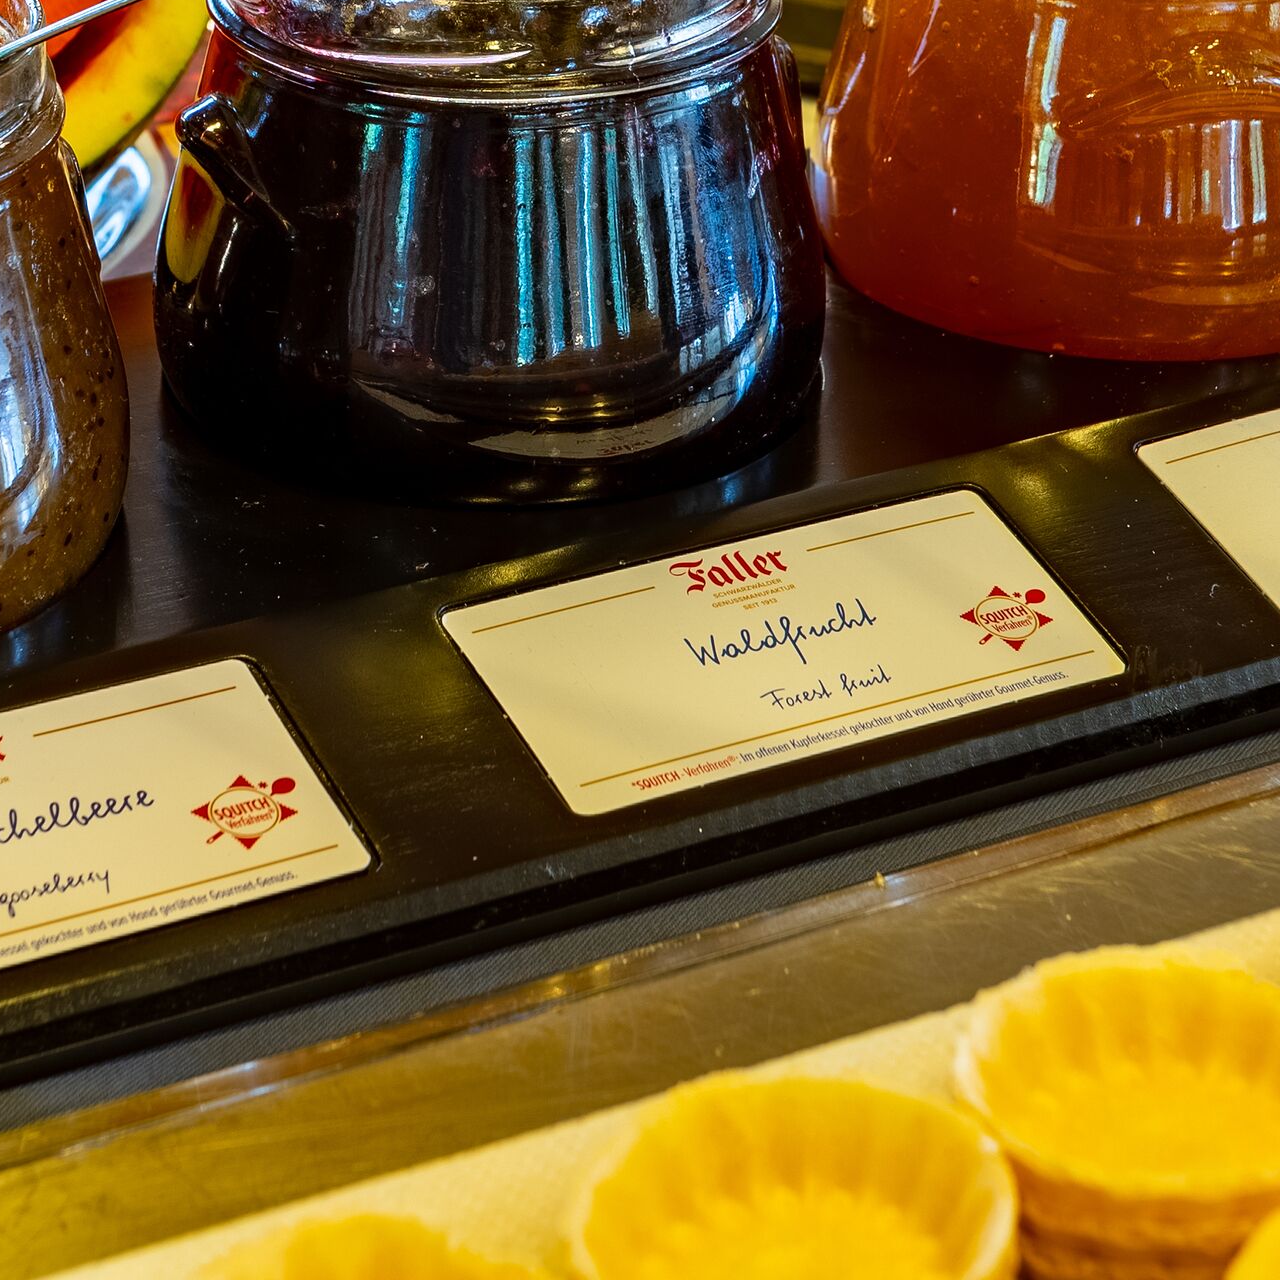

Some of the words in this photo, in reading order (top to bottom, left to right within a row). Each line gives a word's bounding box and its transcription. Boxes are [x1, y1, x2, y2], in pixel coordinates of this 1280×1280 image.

[669, 550, 788, 596] Faller
[712, 583, 796, 608] GENUSSMANUFAKTUR
[684, 598, 877, 666] Waldfrucht
[980, 605, 1028, 625] SQUITCH
[760, 679, 832, 710] Forest
[840, 664, 892, 697] fruit
[739, 752, 755, 763] Im
[755, 742, 790, 759] offenen
[789, 726, 850, 752] Kupferkessel
[851, 716, 895, 735] gekochter
[895, 709, 913, 722] und
[912, 705, 930, 717] von
[928, 698, 955, 713] Hand
[954, 689, 995, 708] gerührter
[214, 796, 272, 821] SQUITCH
